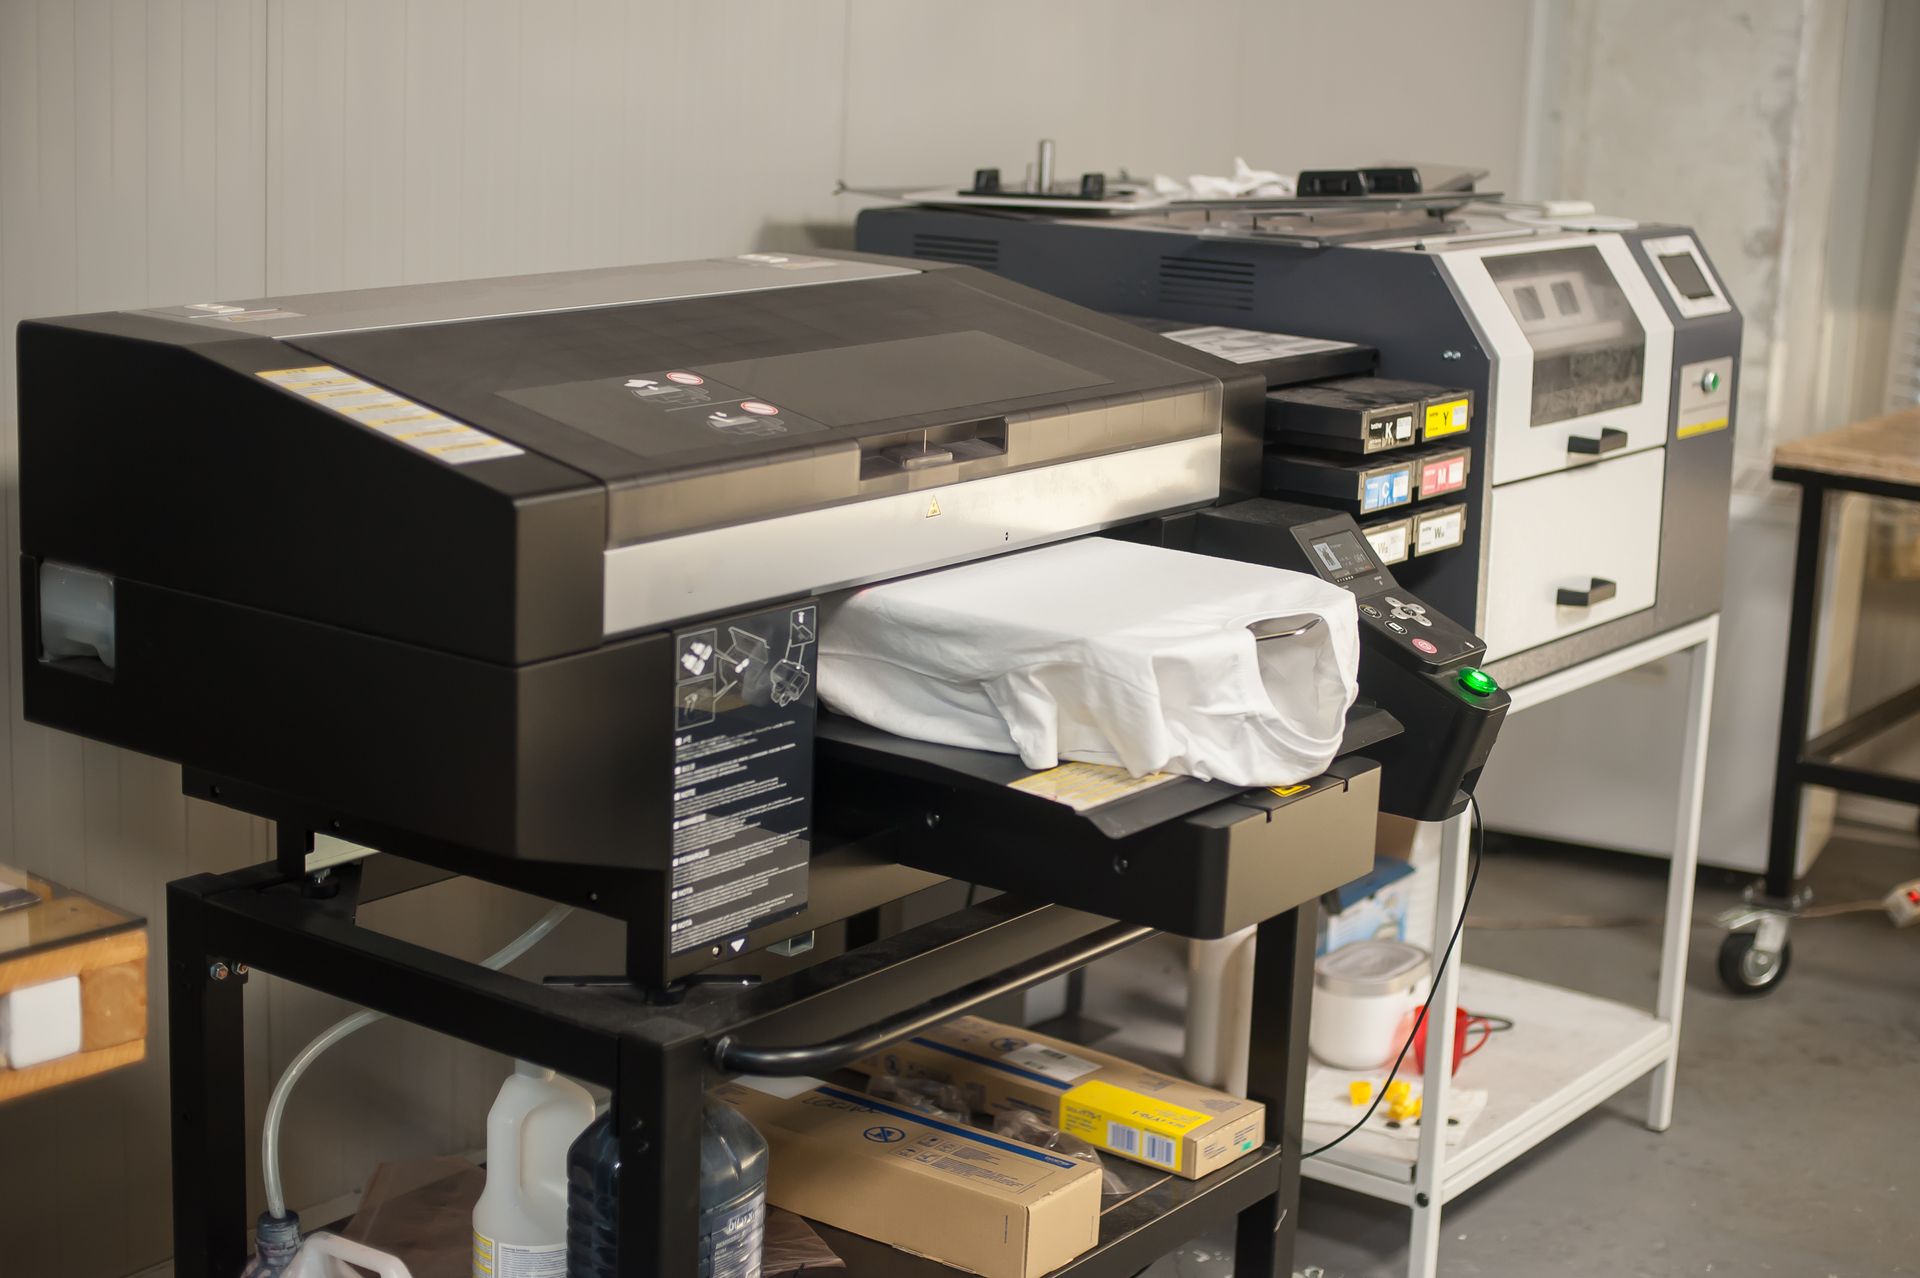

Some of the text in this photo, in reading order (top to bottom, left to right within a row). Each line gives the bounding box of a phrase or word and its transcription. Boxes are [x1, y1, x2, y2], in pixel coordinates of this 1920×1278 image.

[1443, 411, 1449, 426] Y
[1385, 422, 1393, 439] K
[1437, 467, 1447, 485] M
[1381, 481, 1390, 499] C
